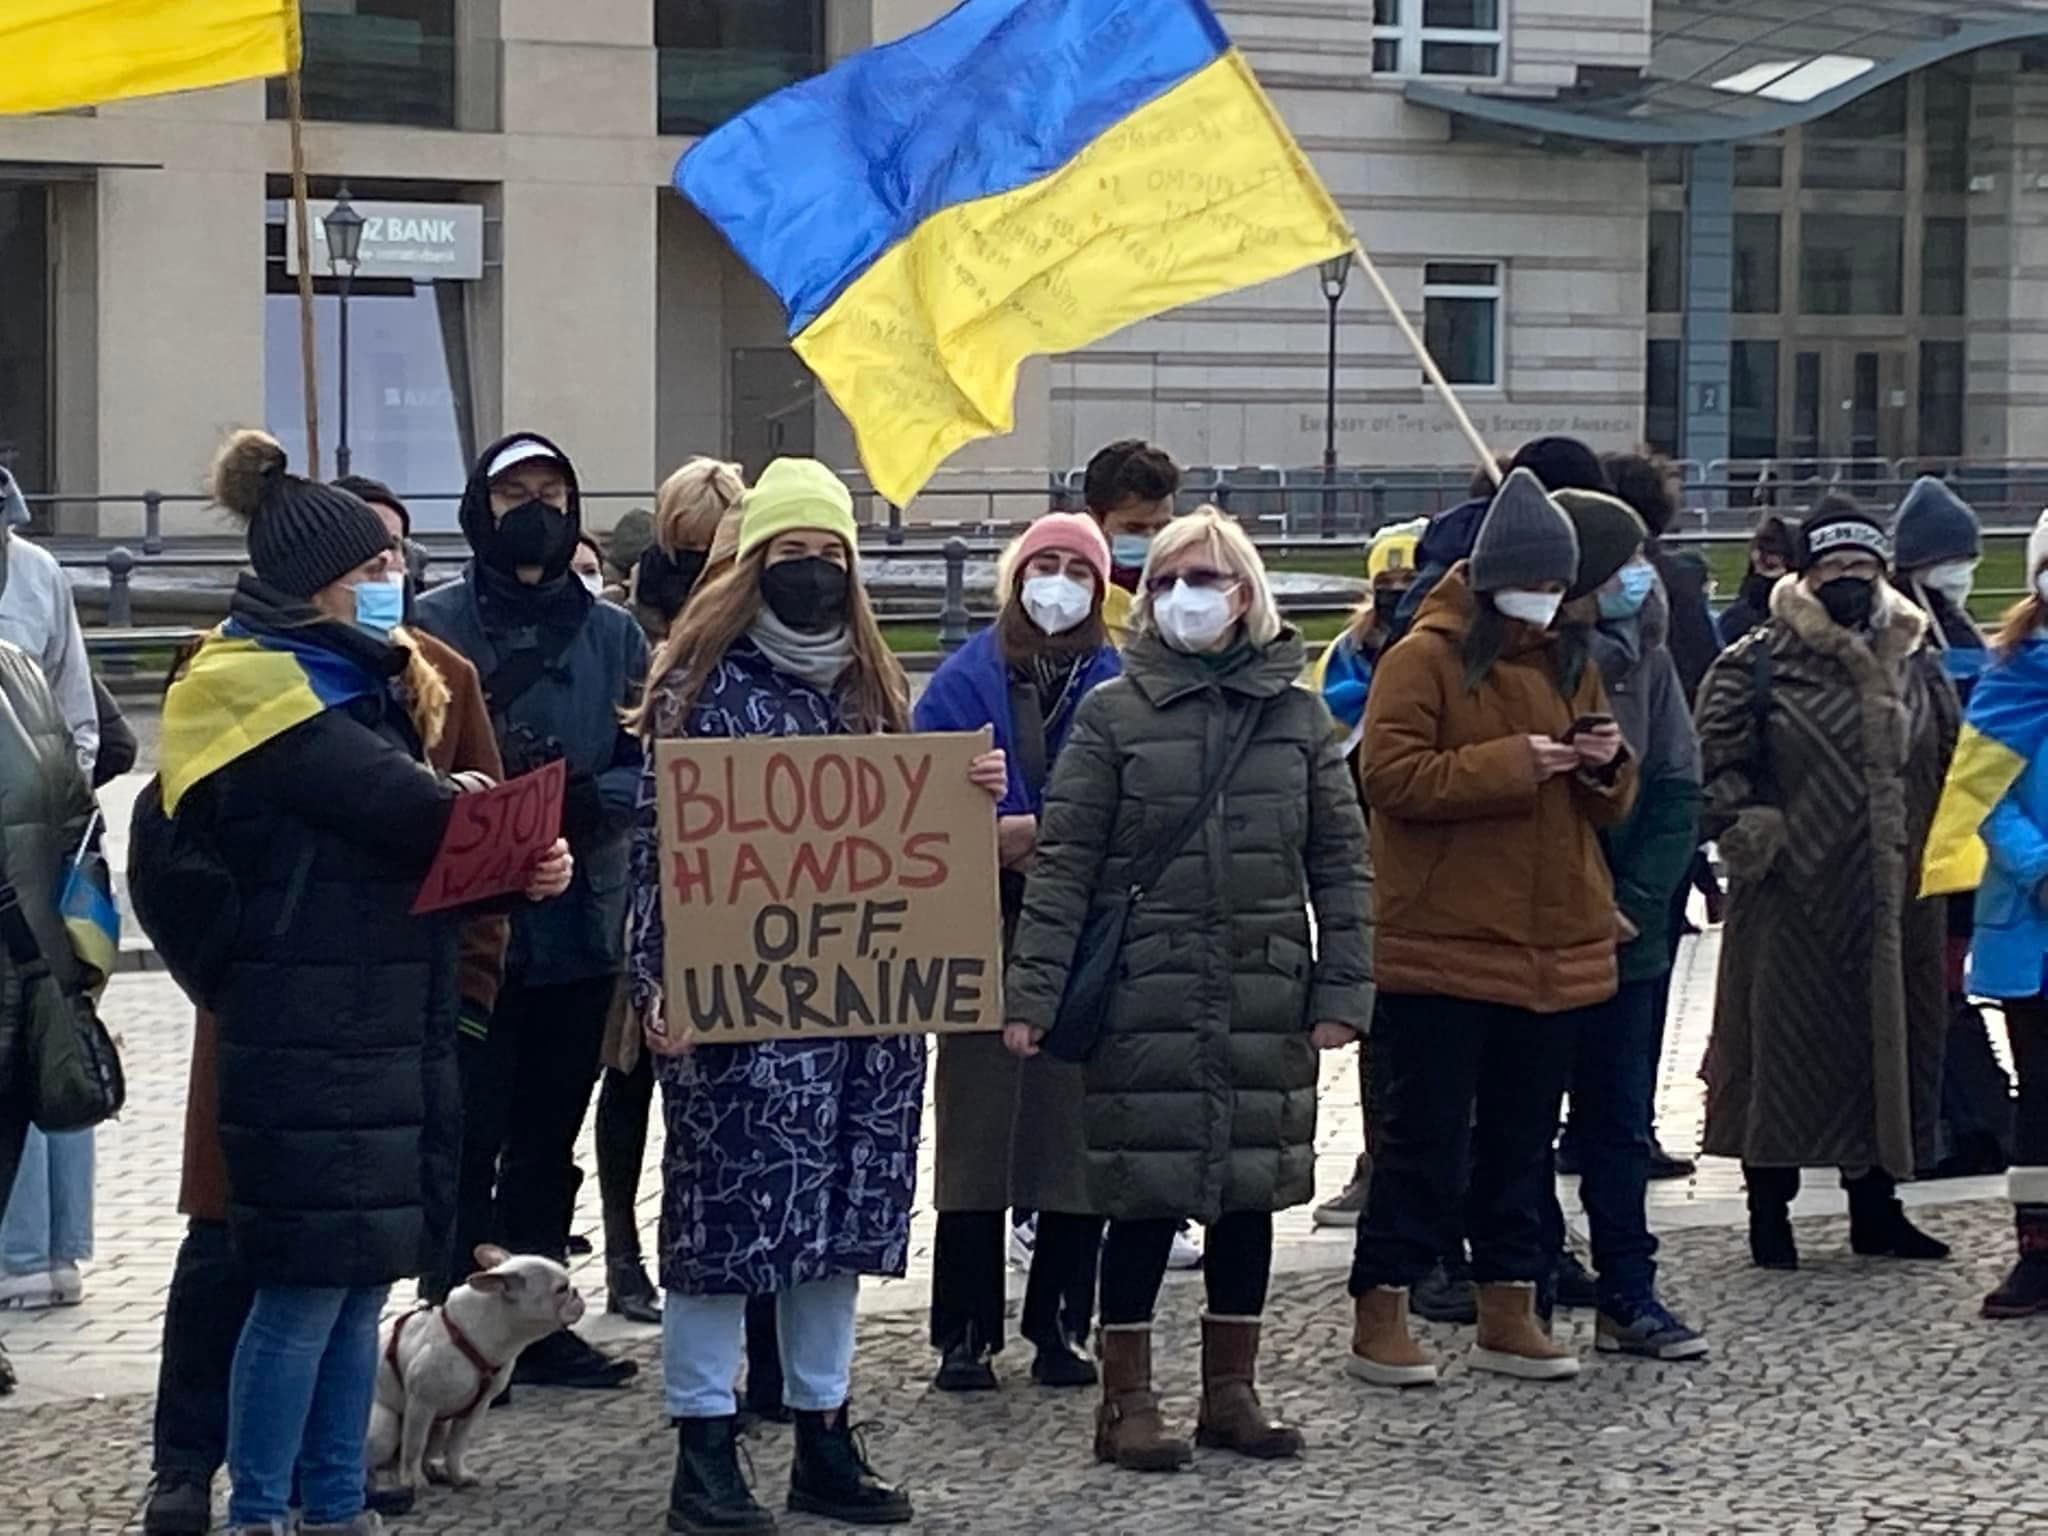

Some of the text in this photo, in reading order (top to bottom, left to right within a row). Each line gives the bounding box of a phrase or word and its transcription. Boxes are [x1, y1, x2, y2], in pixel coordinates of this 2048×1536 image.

[387, 218, 457, 243] BANK
[1300, 413, 1366, 432] EMSSY
[446, 767, 561, 855] STOP
[669, 752, 932, 843] BLOODY
[672, 833, 950, 905] HANDS
[753, 899, 908, 962] OFF
